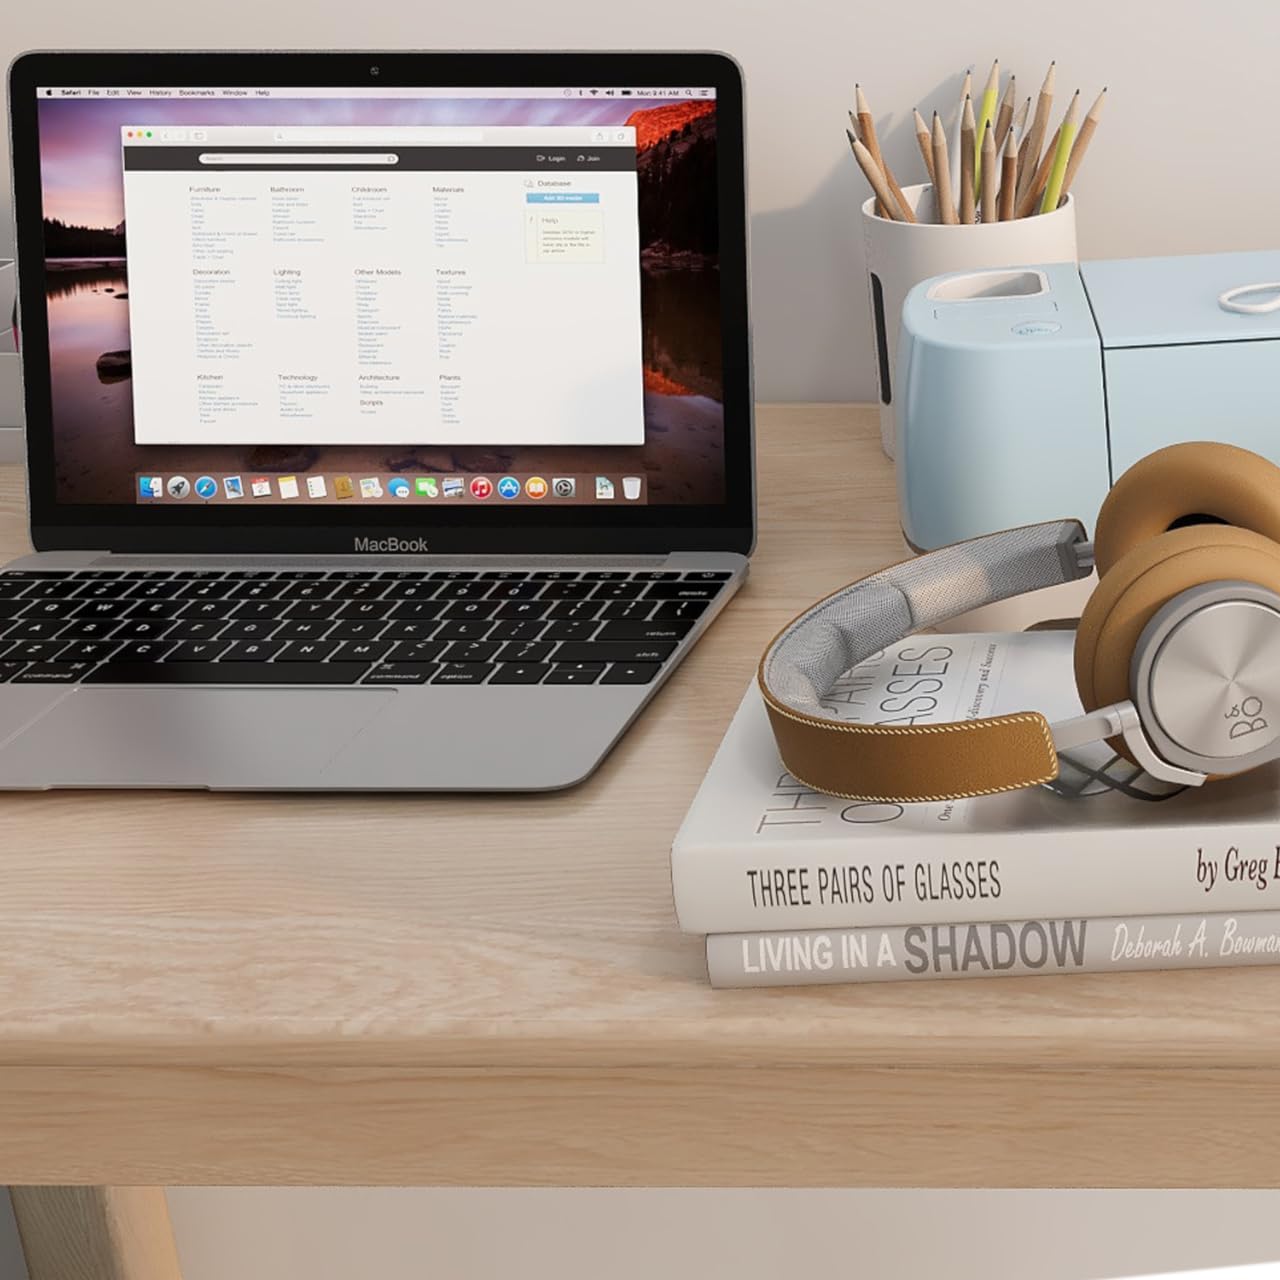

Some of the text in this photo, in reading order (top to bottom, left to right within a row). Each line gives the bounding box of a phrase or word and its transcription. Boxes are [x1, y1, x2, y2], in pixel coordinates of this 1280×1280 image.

[61, 89, 270, 98] Safari File Edit View History Bookmarks Window Help
[548, 155, 566, 163] Login
[542, 217, 559, 225] Help
[273, 269, 301, 277] Lighting
[278, 374, 318, 382] Technology
[354, 536, 428, 553] MacBook
[840, 802, 905, 824] O
[1196, 847, 1218, 892] by
[1224, 846, 1268, 891] Greg
[747, 860, 1002, 908] THREE PAIRS OF GLASSES
[742, 920, 1088, 974] LIVING IN A SHADOW
[1111, 922, 1182, 962] Deborah
[1188, 919, 1209, 958] A.
